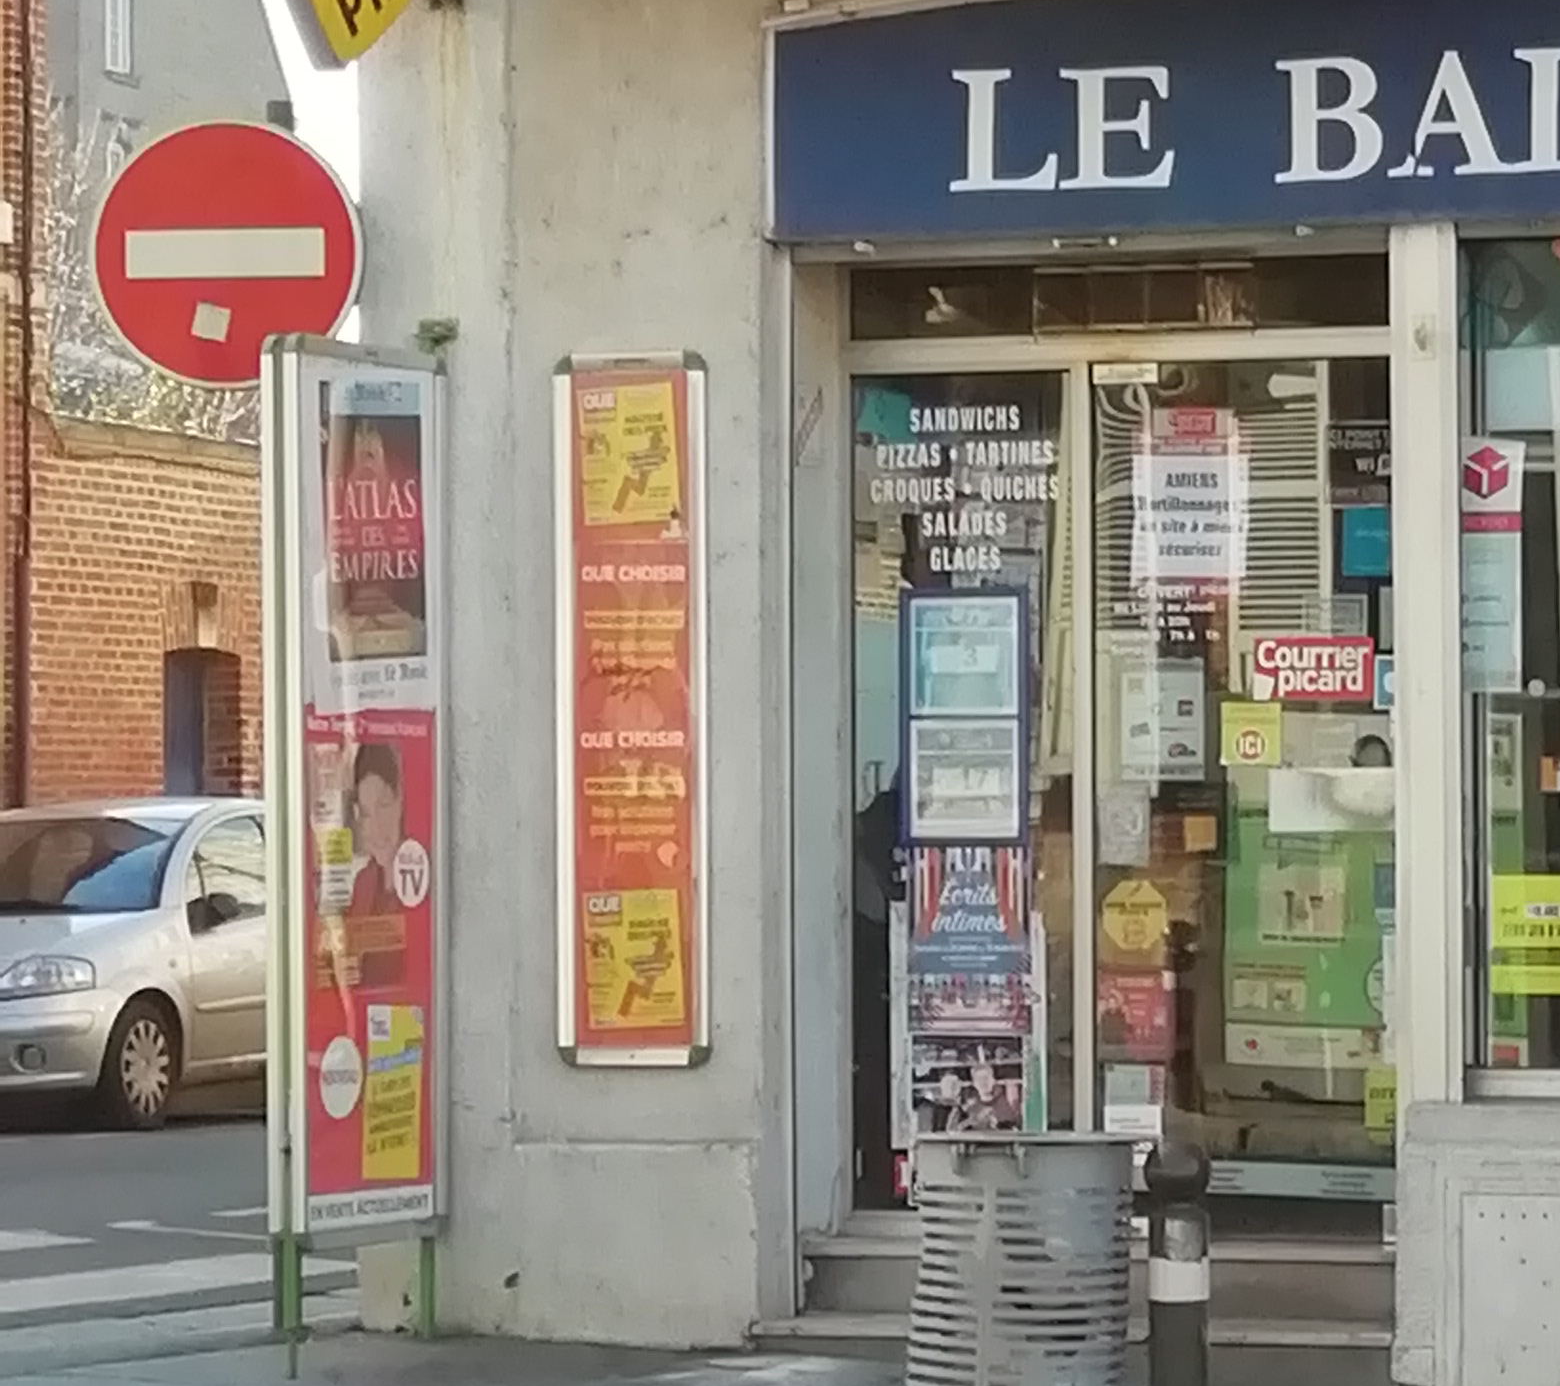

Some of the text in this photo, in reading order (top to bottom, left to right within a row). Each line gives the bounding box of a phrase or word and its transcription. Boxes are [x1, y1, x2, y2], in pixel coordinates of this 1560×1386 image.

[950, 67, 1174, 191] LE
[909, 406, 1021, 433] SANDWICHS
[876, 440, 1055, 469] PIZZAS TARTINES
[870, 474, 1060, 503] CROQUES QUICHES
[1164, 472, 1219, 489] AMIENS
[922, 511, 1008, 537] SALADES
[330, 549, 419, 584] EMPIRES
[930, 546, 1001, 571] GLACES
[581, 564, 615, 582] QUE
[1257, 640, 1370, 669] Courrier
[1277, 665, 1364, 698] picard
[580, 731, 614, 749] QUE
[1239, 735, 1262, 755] ICI
[399, 868, 424, 897] TV
